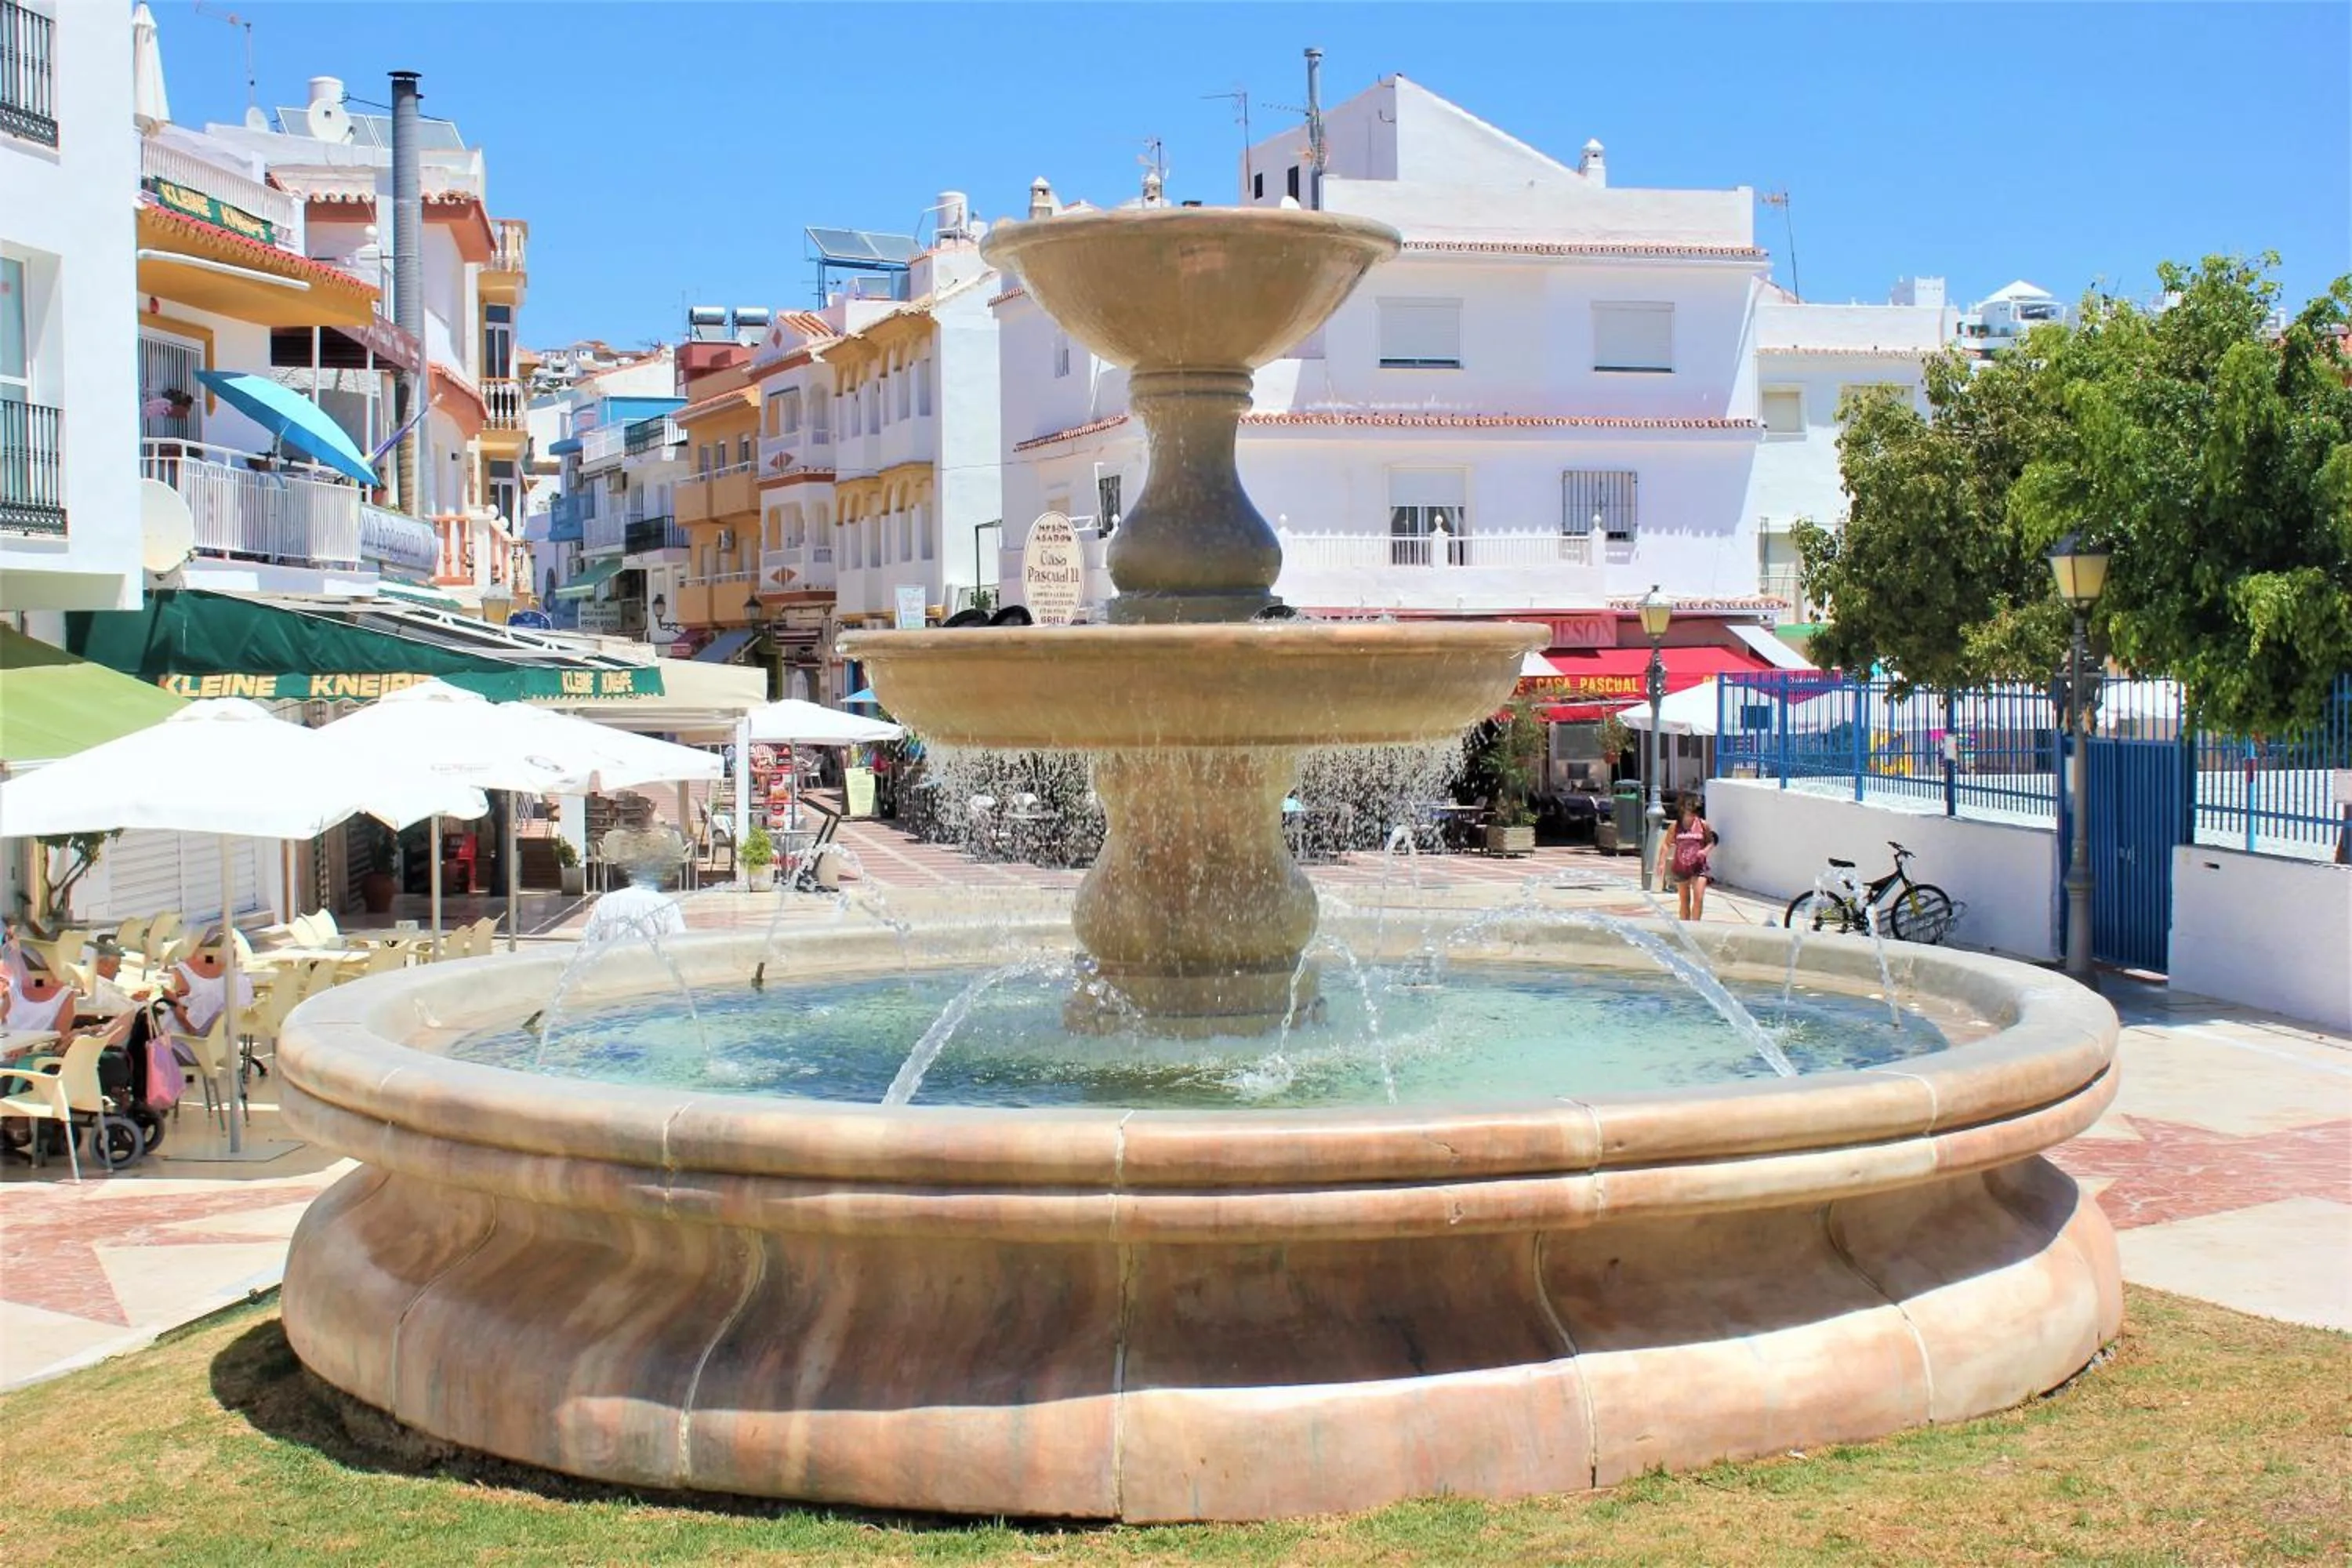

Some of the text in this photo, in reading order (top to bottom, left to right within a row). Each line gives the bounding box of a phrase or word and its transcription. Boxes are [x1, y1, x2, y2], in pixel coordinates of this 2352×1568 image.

[1028, 565, 1069, 583] Pascual
[159, 673, 277, 697] KLEINE
[1536, 676, 1571, 694] CASA
[1580, 676, 1640, 693] PASCUAL
